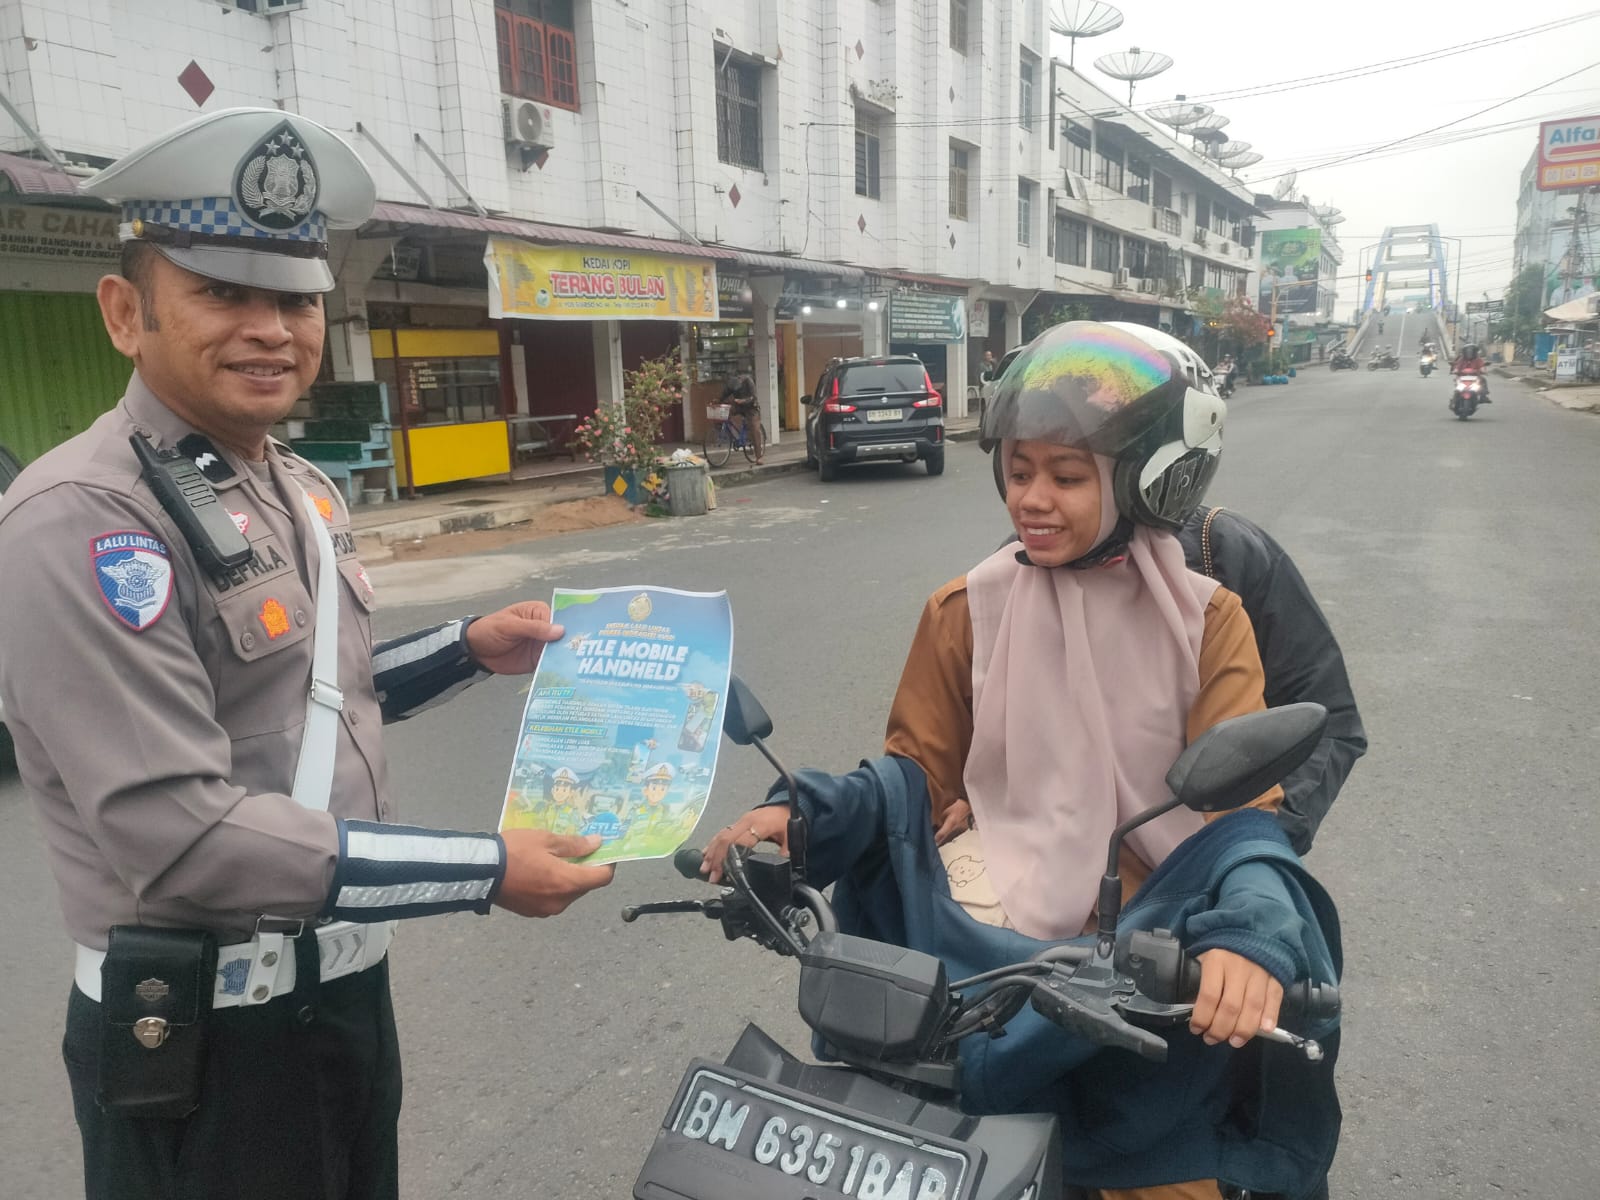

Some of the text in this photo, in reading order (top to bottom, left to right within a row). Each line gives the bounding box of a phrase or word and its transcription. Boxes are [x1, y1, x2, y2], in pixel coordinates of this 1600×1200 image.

[1549, 127, 1600, 145] Alfa
[583, 257, 631, 270] KEDAI KOPI
[550, 272, 616, 296] TERANG
[619, 275, 665, 298] BULAN
[96, 535, 167, 554] LALU LINTAS
[576, 640, 689, 662] ETLE MOBILE
[578, 657, 681, 680] HANDHELD
[587, 822, 618, 836] ETLE
[682, 1090, 750, 1150] BM
